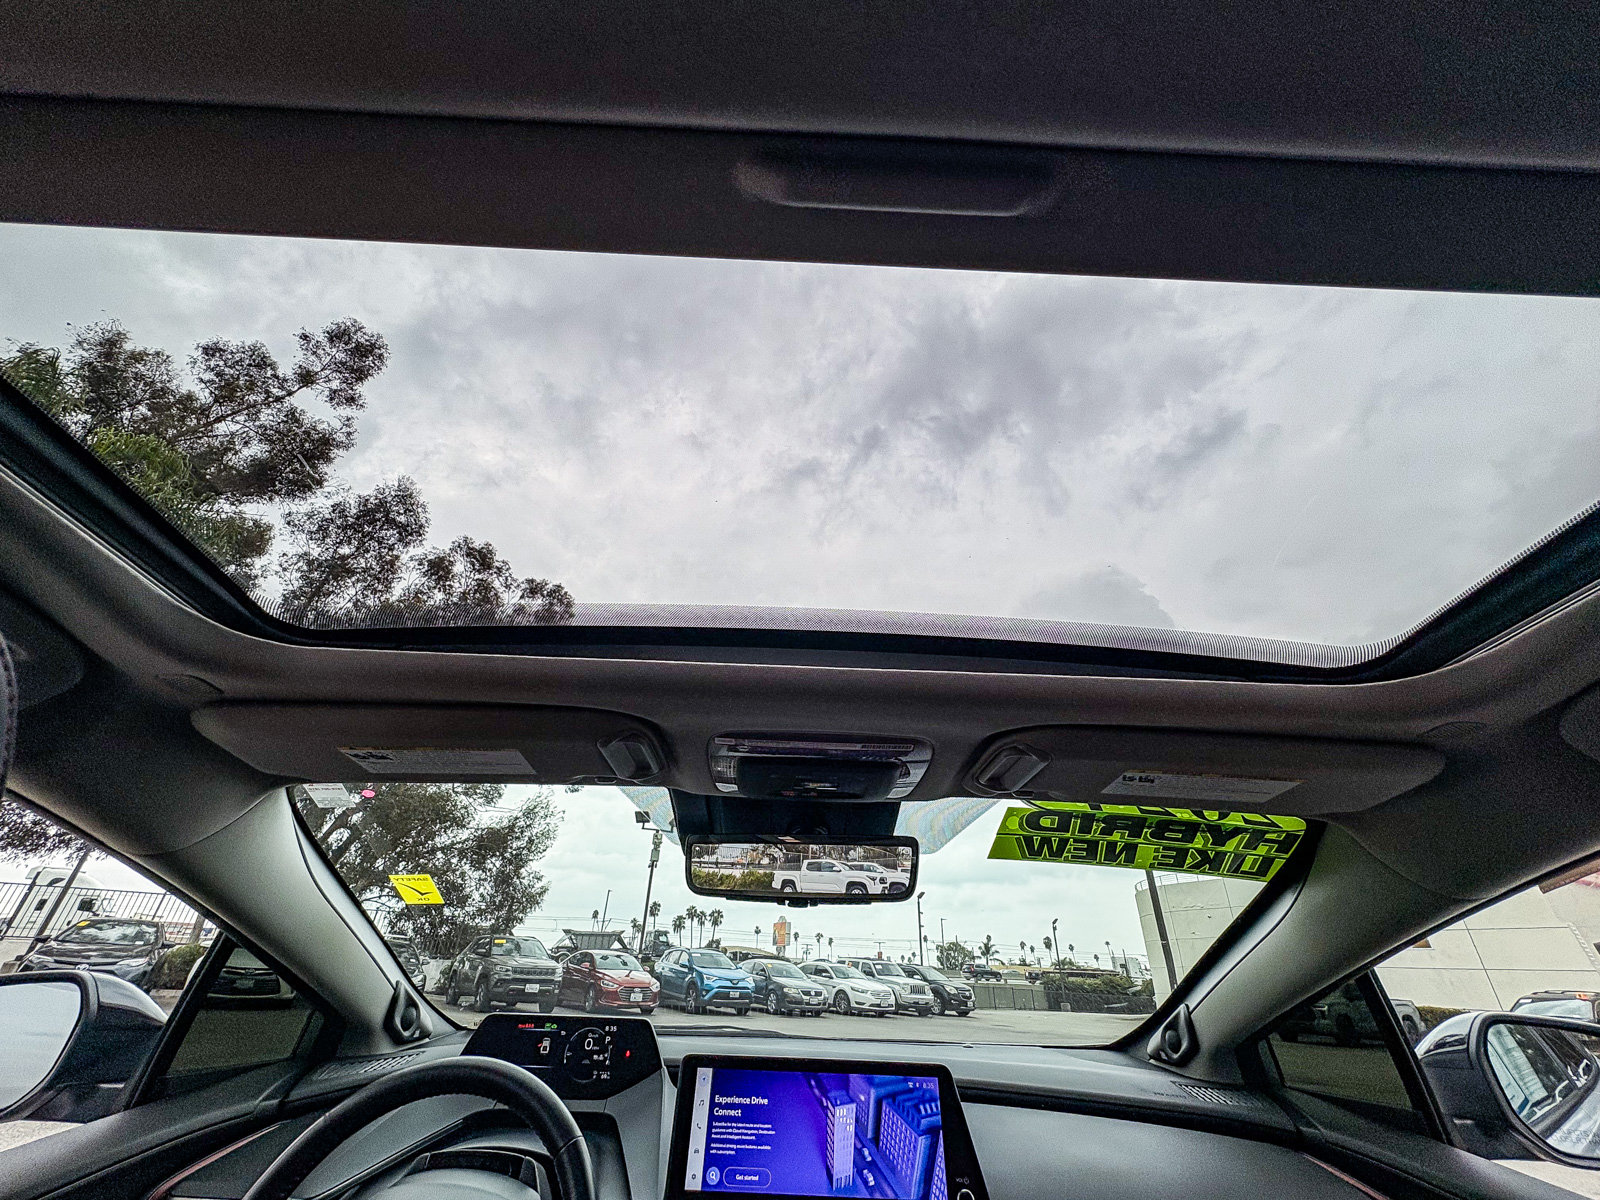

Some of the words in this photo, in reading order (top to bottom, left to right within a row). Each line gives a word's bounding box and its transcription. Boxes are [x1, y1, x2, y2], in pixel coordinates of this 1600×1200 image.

[584, 1038, 593, 1050] 0
[605, 1036, 611, 1044] P
[715, 1095, 750, 1105] Experience
[750, 1096, 768, 1105] Drive
[713, 1107, 742, 1117] Connect
